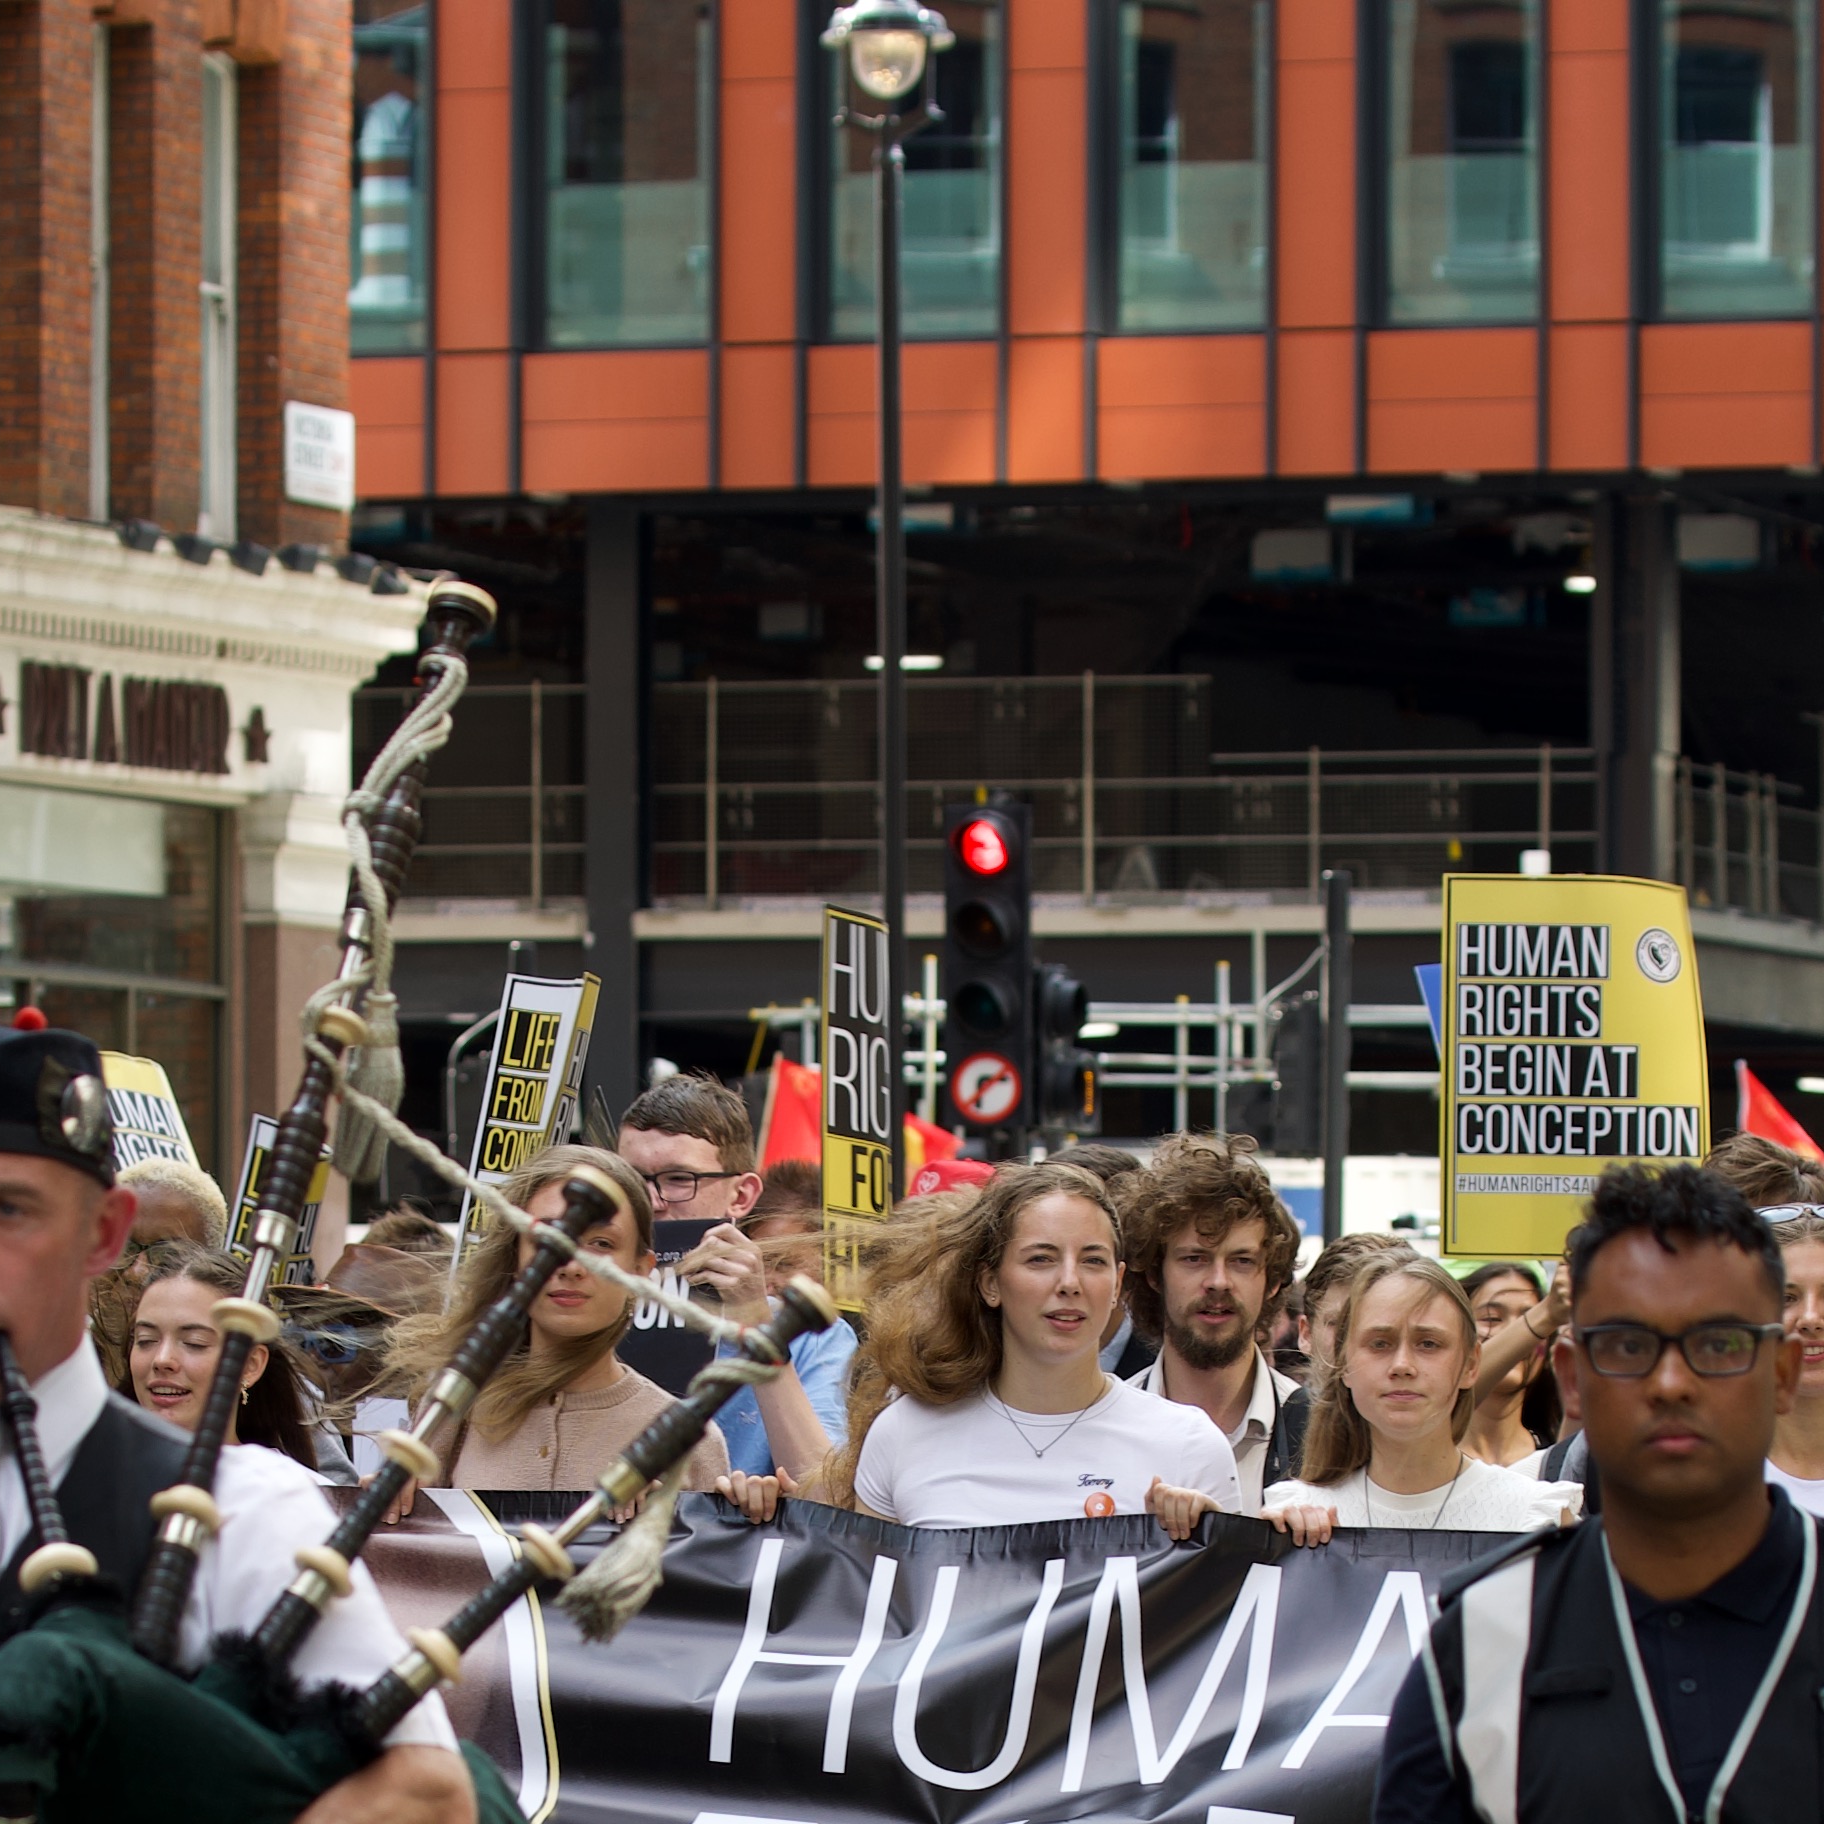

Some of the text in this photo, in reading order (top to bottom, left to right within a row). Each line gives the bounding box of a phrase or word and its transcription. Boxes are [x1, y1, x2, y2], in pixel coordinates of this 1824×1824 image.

[1459, 924, 1608, 977] HUMAN
[1459, 984, 1601, 1037] RIGHTS
[502, 1010, 561, 1070] LIFE
[1458, 1044, 1638, 1097] BEGIN AT
[107, 1088, 181, 1142] UMAN
[491, 1075, 548, 1123] FROM
[1459, 1104, 1699, 1156] CONCEPTION
[851, 1144, 891, 1214] FO
[1457, 1176, 1598, 1193] #HUMANRIGHTS4AL
[1077, 1474, 1114, 1489] Tommy
[708, 1538, 1441, 1792] HUMA
